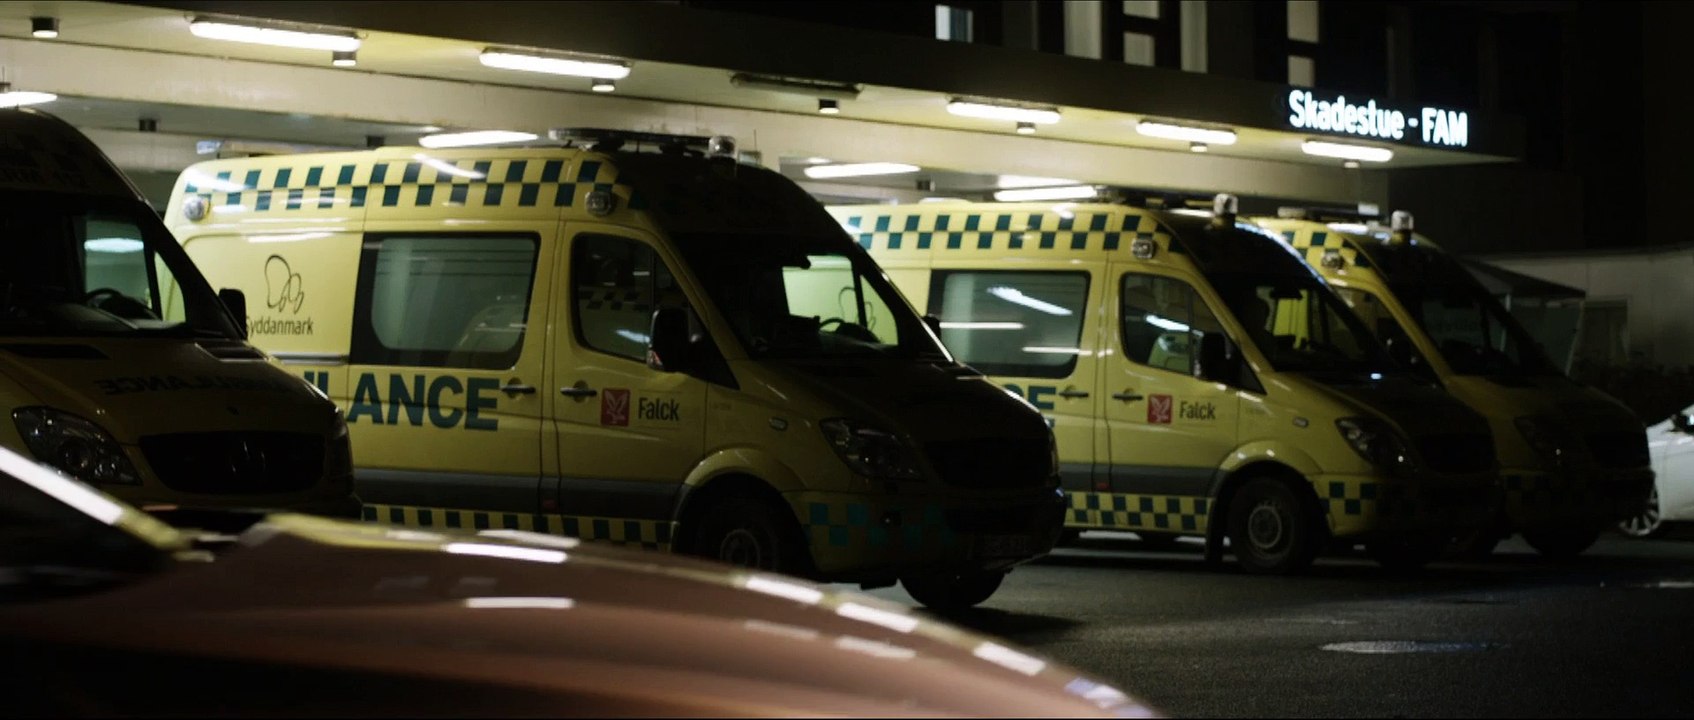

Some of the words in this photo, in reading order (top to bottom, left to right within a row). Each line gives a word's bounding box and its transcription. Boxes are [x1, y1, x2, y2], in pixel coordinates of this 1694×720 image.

[1288, 89, 1405, 140] Skadestue
[1421, 106, 1468, 147] FAM
[246, 316, 314, 338] yddanmark
[304, 371, 501, 430] ANCE
[638, 397, 680, 421] Falck
[1179, 401, 1216, 420] Falck
